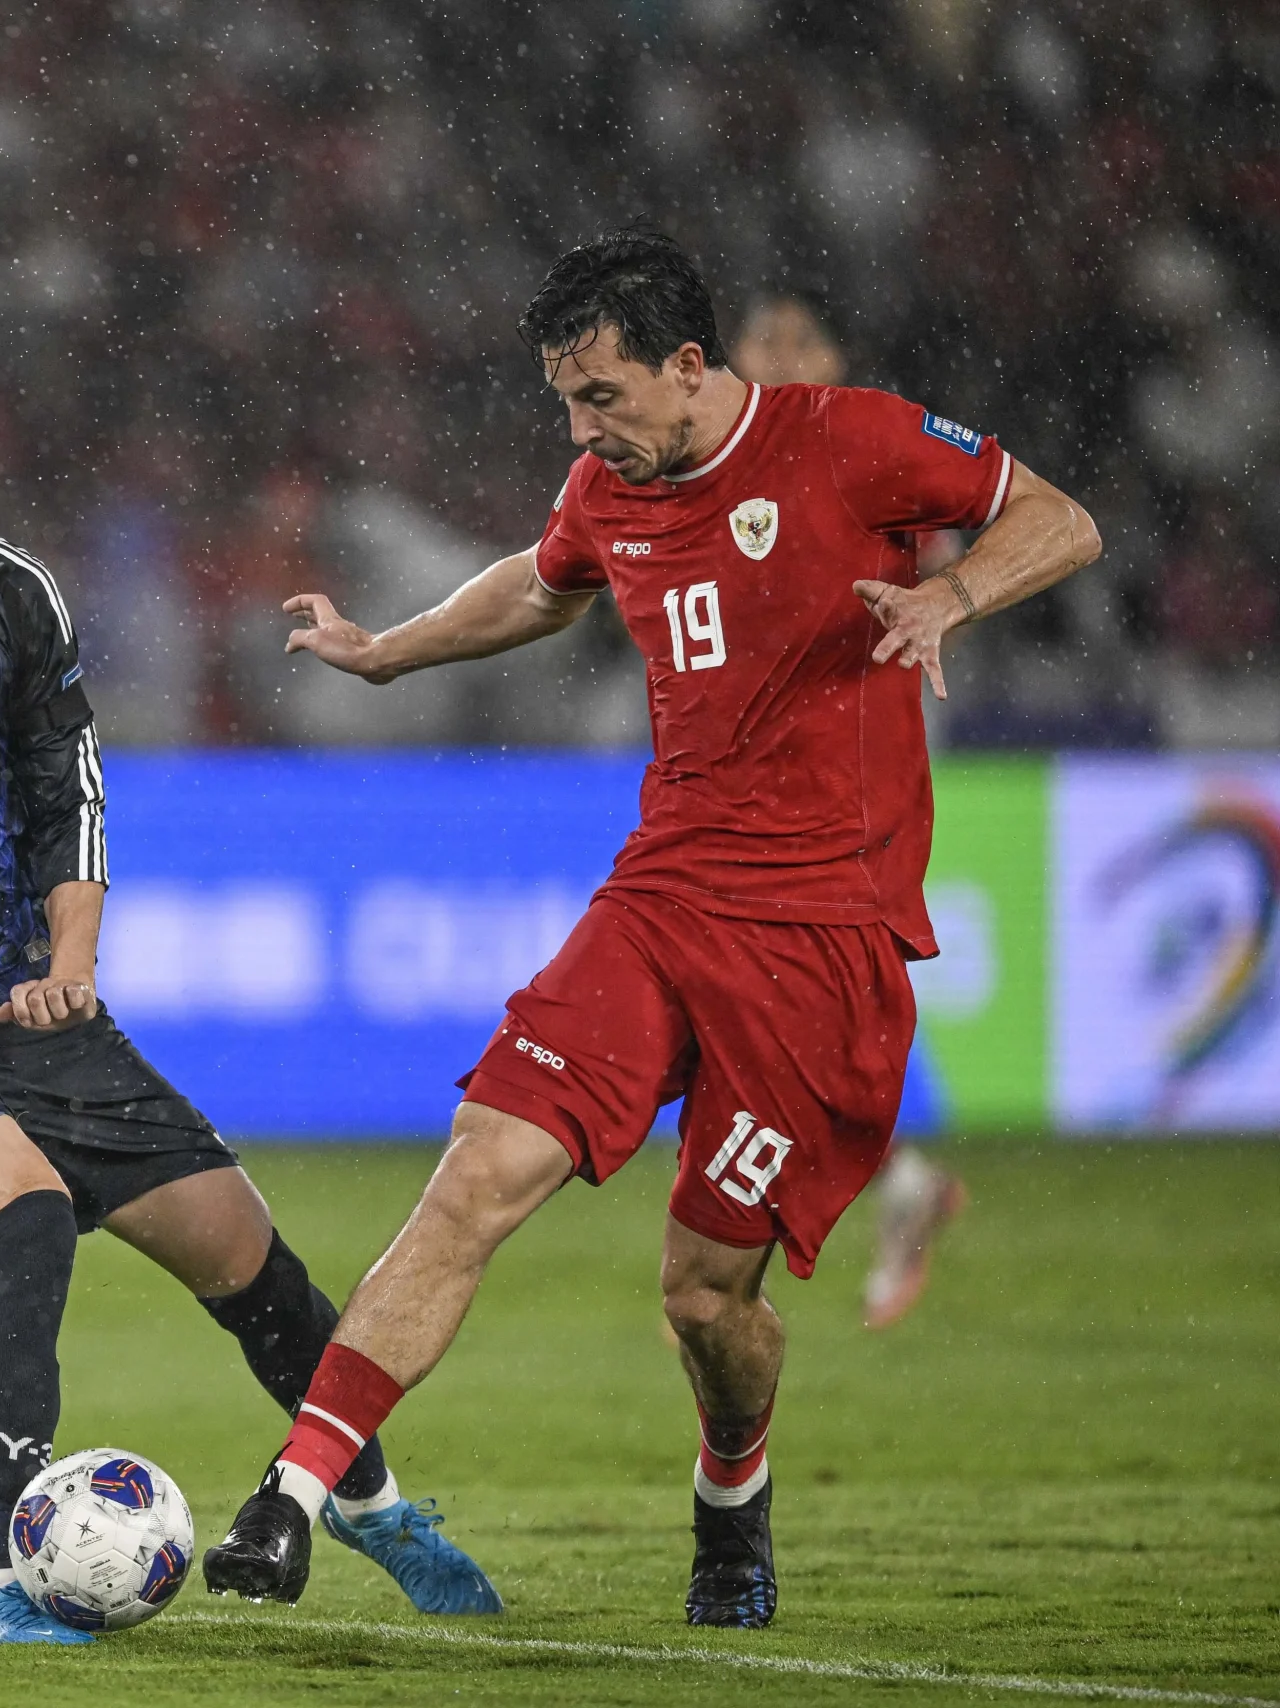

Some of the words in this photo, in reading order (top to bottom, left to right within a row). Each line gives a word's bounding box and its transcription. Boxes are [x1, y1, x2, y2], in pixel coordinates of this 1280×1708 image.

[612, 541, 651, 558] erspo
[662, 580, 727, 673] 19
[515, 1036, 565, 1071] erspo
[704, 1110, 795, 1207] 19
